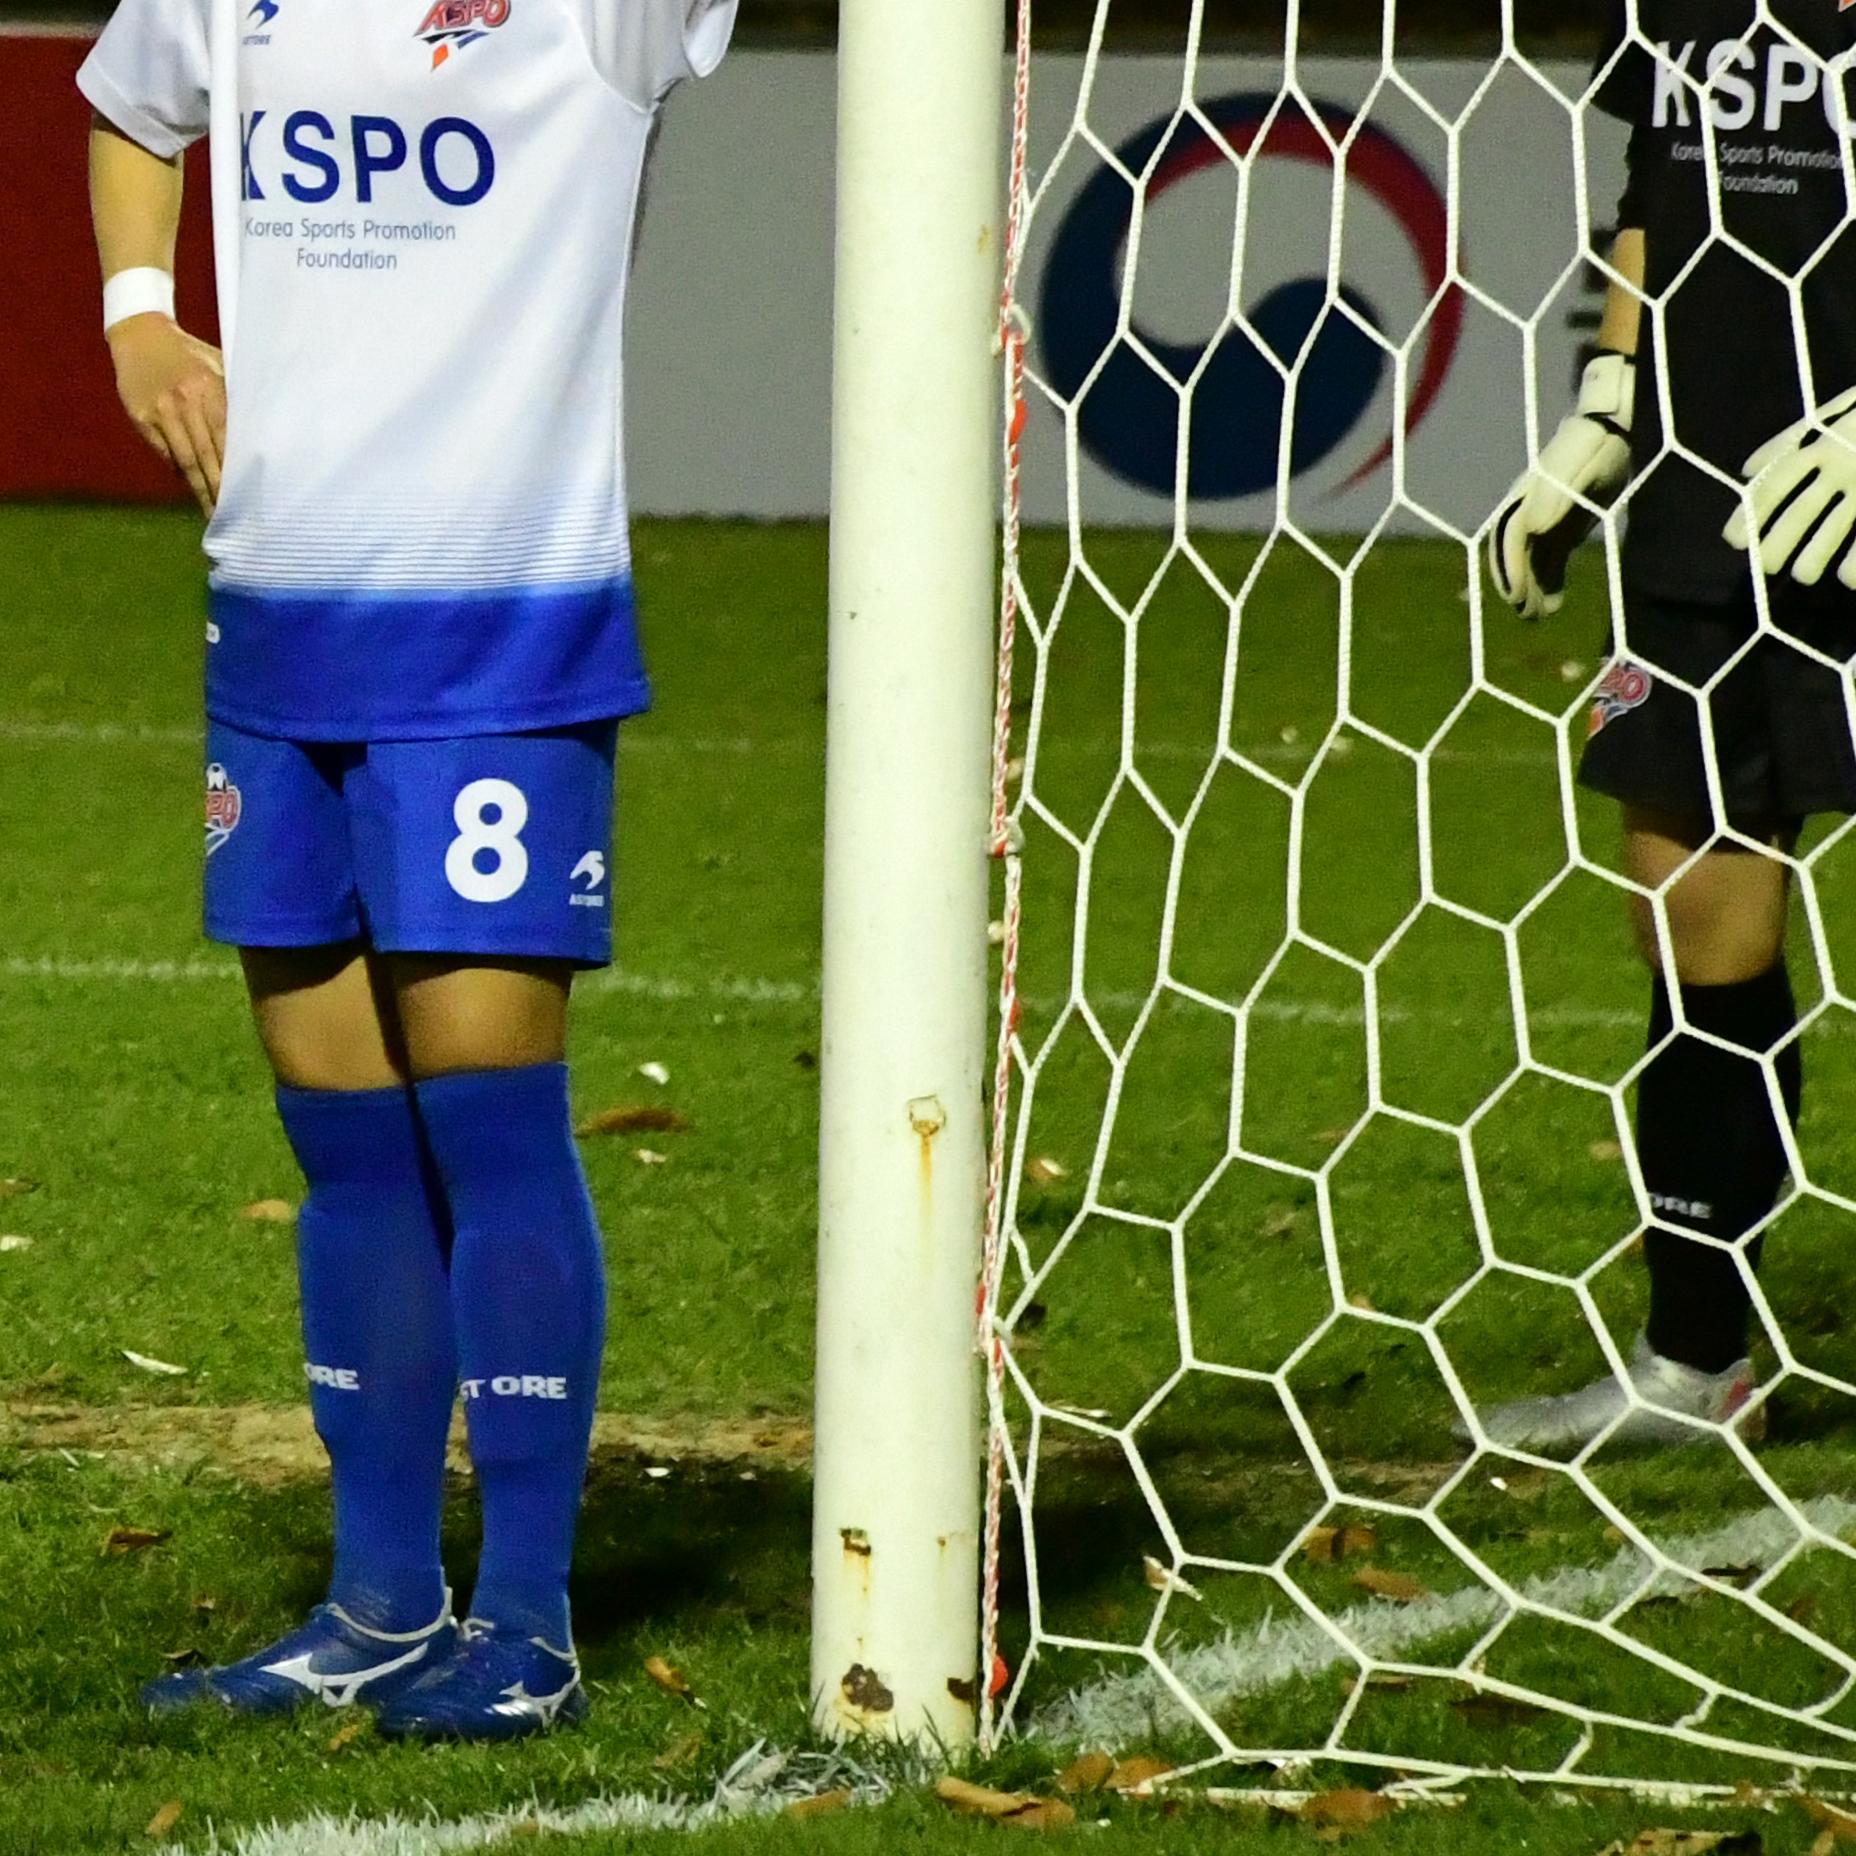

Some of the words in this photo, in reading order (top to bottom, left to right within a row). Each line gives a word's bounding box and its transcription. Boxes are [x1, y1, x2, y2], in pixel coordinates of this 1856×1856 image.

[239, 109, 496, 207] KSPO
[1670, 143, 1706, 162] Kore
[1719, 143, 1763, 167] Sports
[1767, 144, 1846, 170] Promotio
[244, 216, 294, 238] Korea
[300, 218, 356, 246] Sports
[363, 219, 457, 241] Promotion
[296, 247, 398, 270] Foundation
[444, 777, 529, 903] 8
[491, 1375, 568, 1400] ORE
